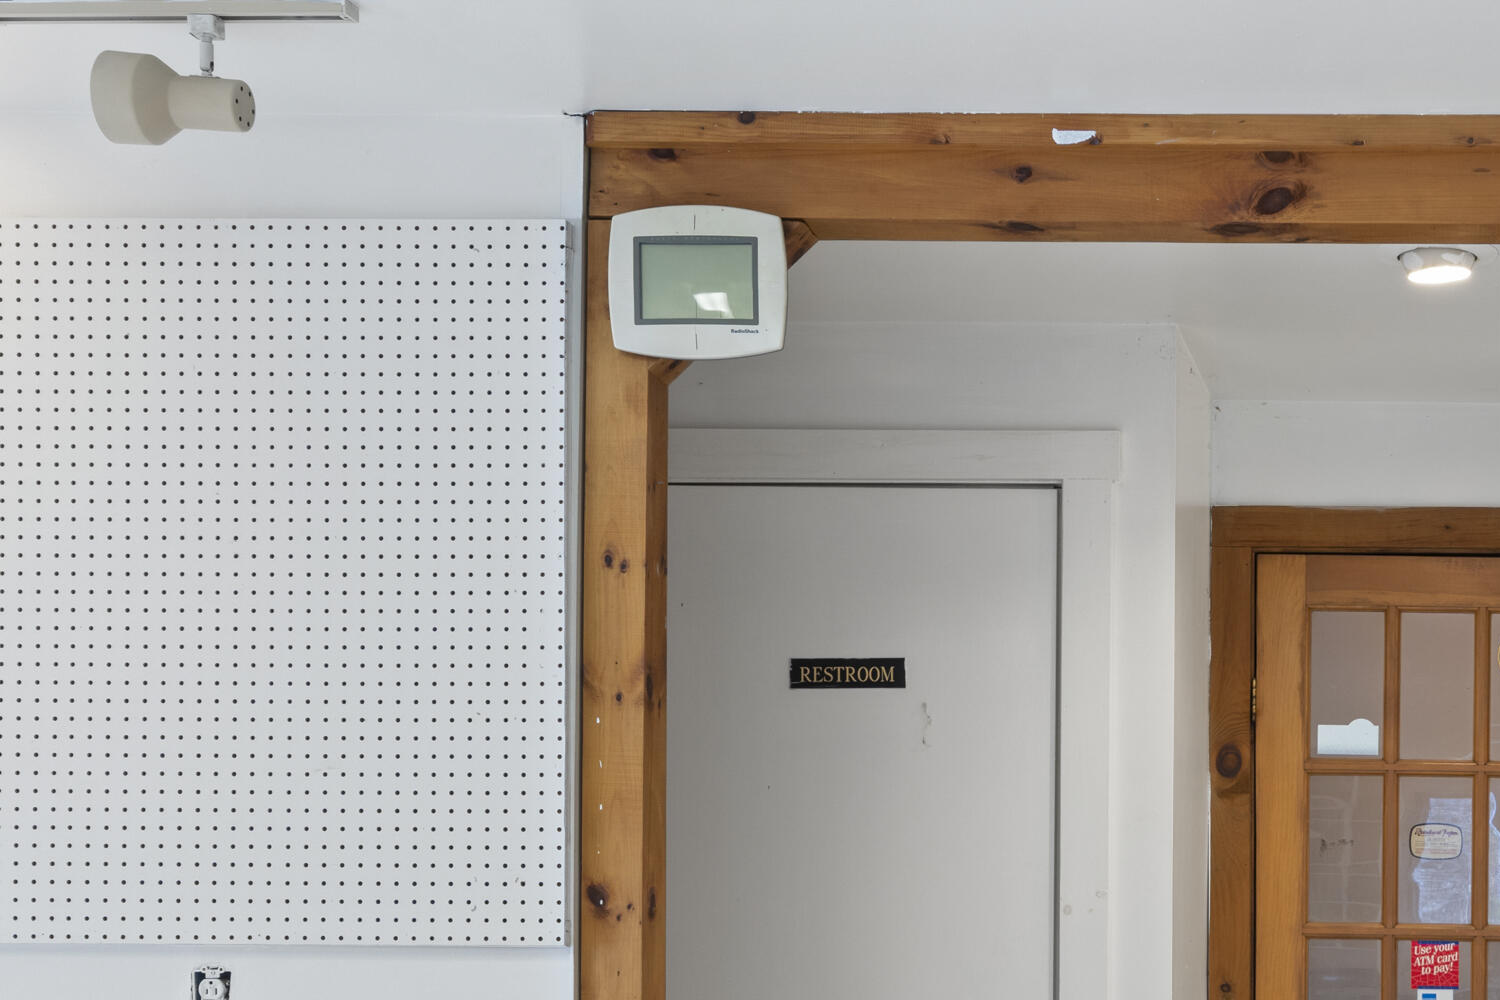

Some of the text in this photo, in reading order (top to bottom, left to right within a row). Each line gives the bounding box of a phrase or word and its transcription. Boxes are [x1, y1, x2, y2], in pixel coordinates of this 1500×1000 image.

[800, 666, 895, 683] RESTROOM
[1414, 942, 1456, 956] Use your
[1413, 951, 1458, 967] ATM card
[1421, 961, 1454, 975] to pay!
